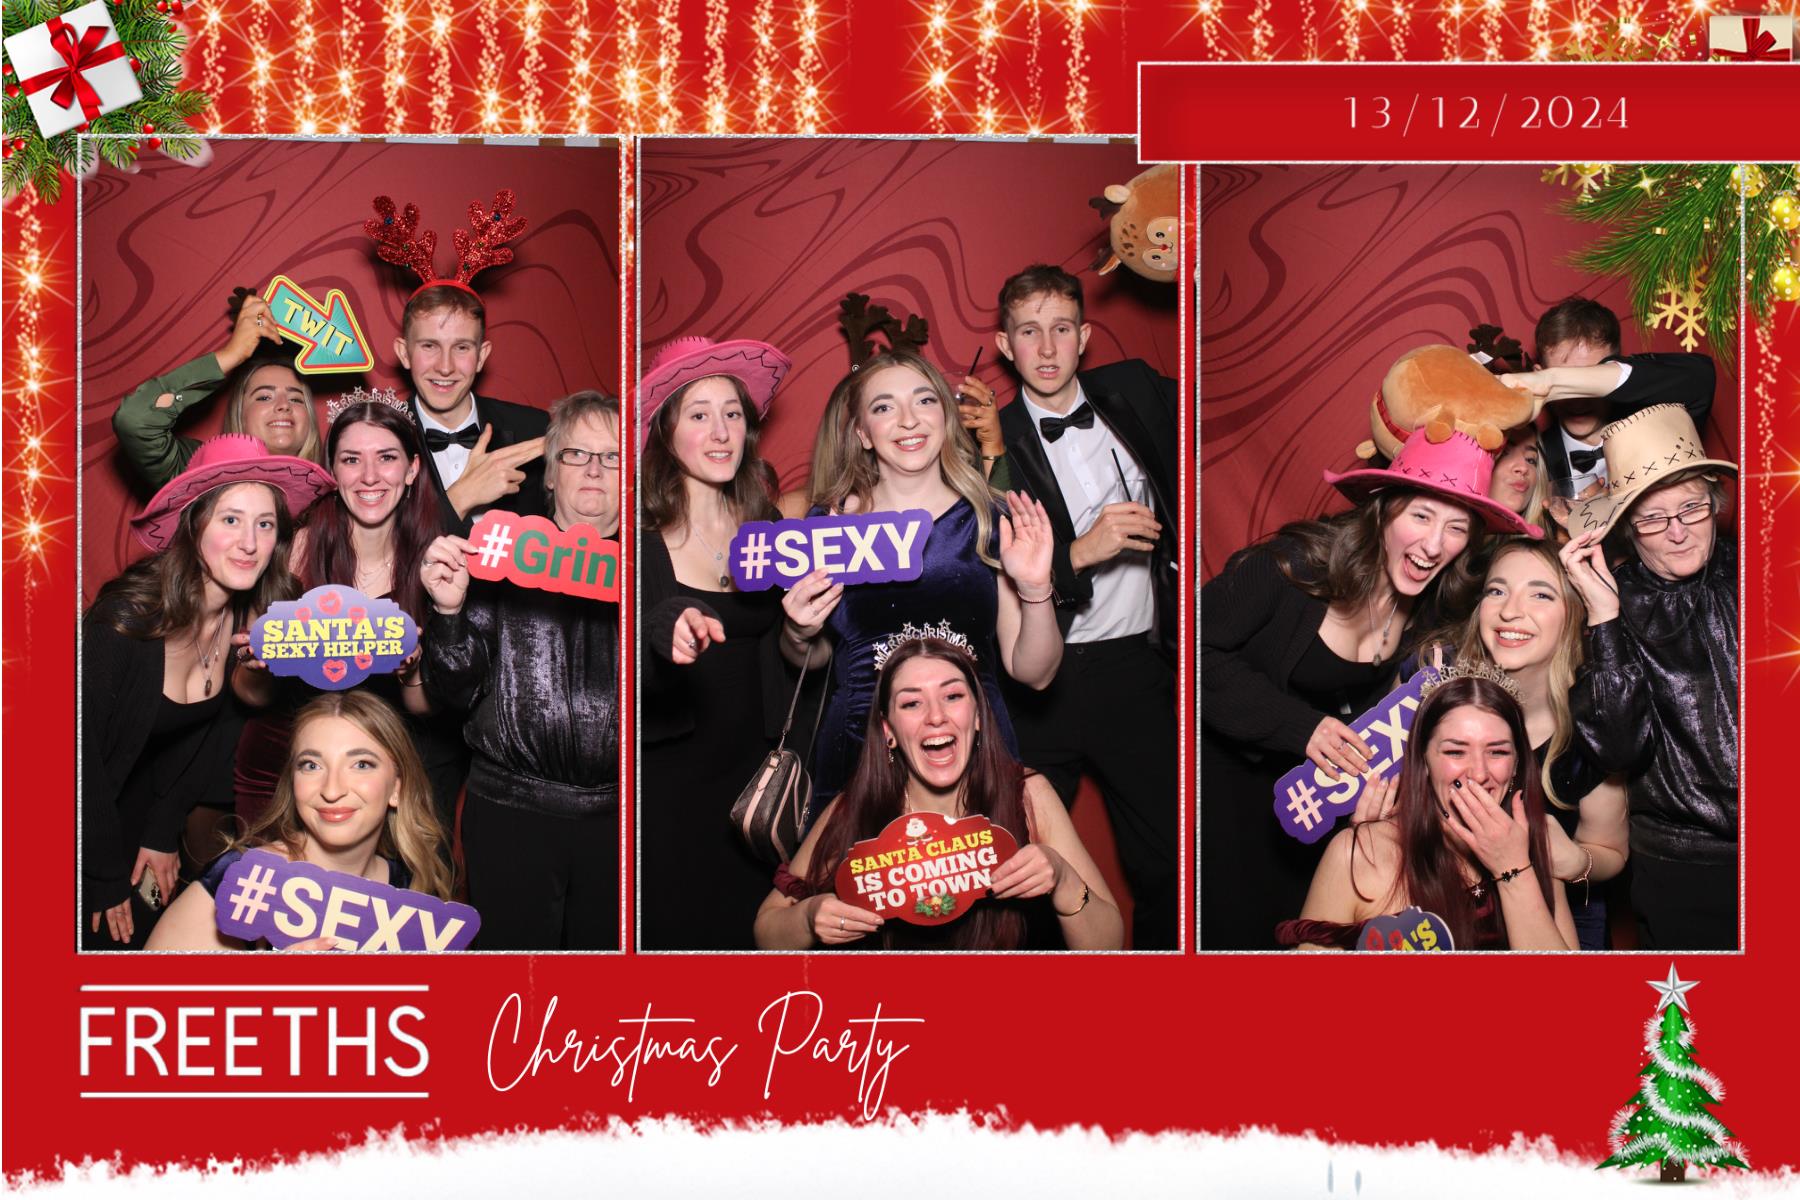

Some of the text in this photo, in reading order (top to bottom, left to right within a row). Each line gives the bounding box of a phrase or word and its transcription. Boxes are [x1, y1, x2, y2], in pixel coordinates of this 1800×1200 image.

[284, 297, 354, 357] TWIT
[478, 523, 617, 589] #Grin
[739, 520, 921, 580] #SEXY
[262, 640, 403, 659] SEXY HELPER
[263, 616, 405, 643] SANTA'S
[850, 829, 994, 874] SANTA CLAUS
[854, 846, 998, 895] IS COMING
[229, 864, 466, 950] #SEXY
[868, 868, 993, 911] TO TOWN
